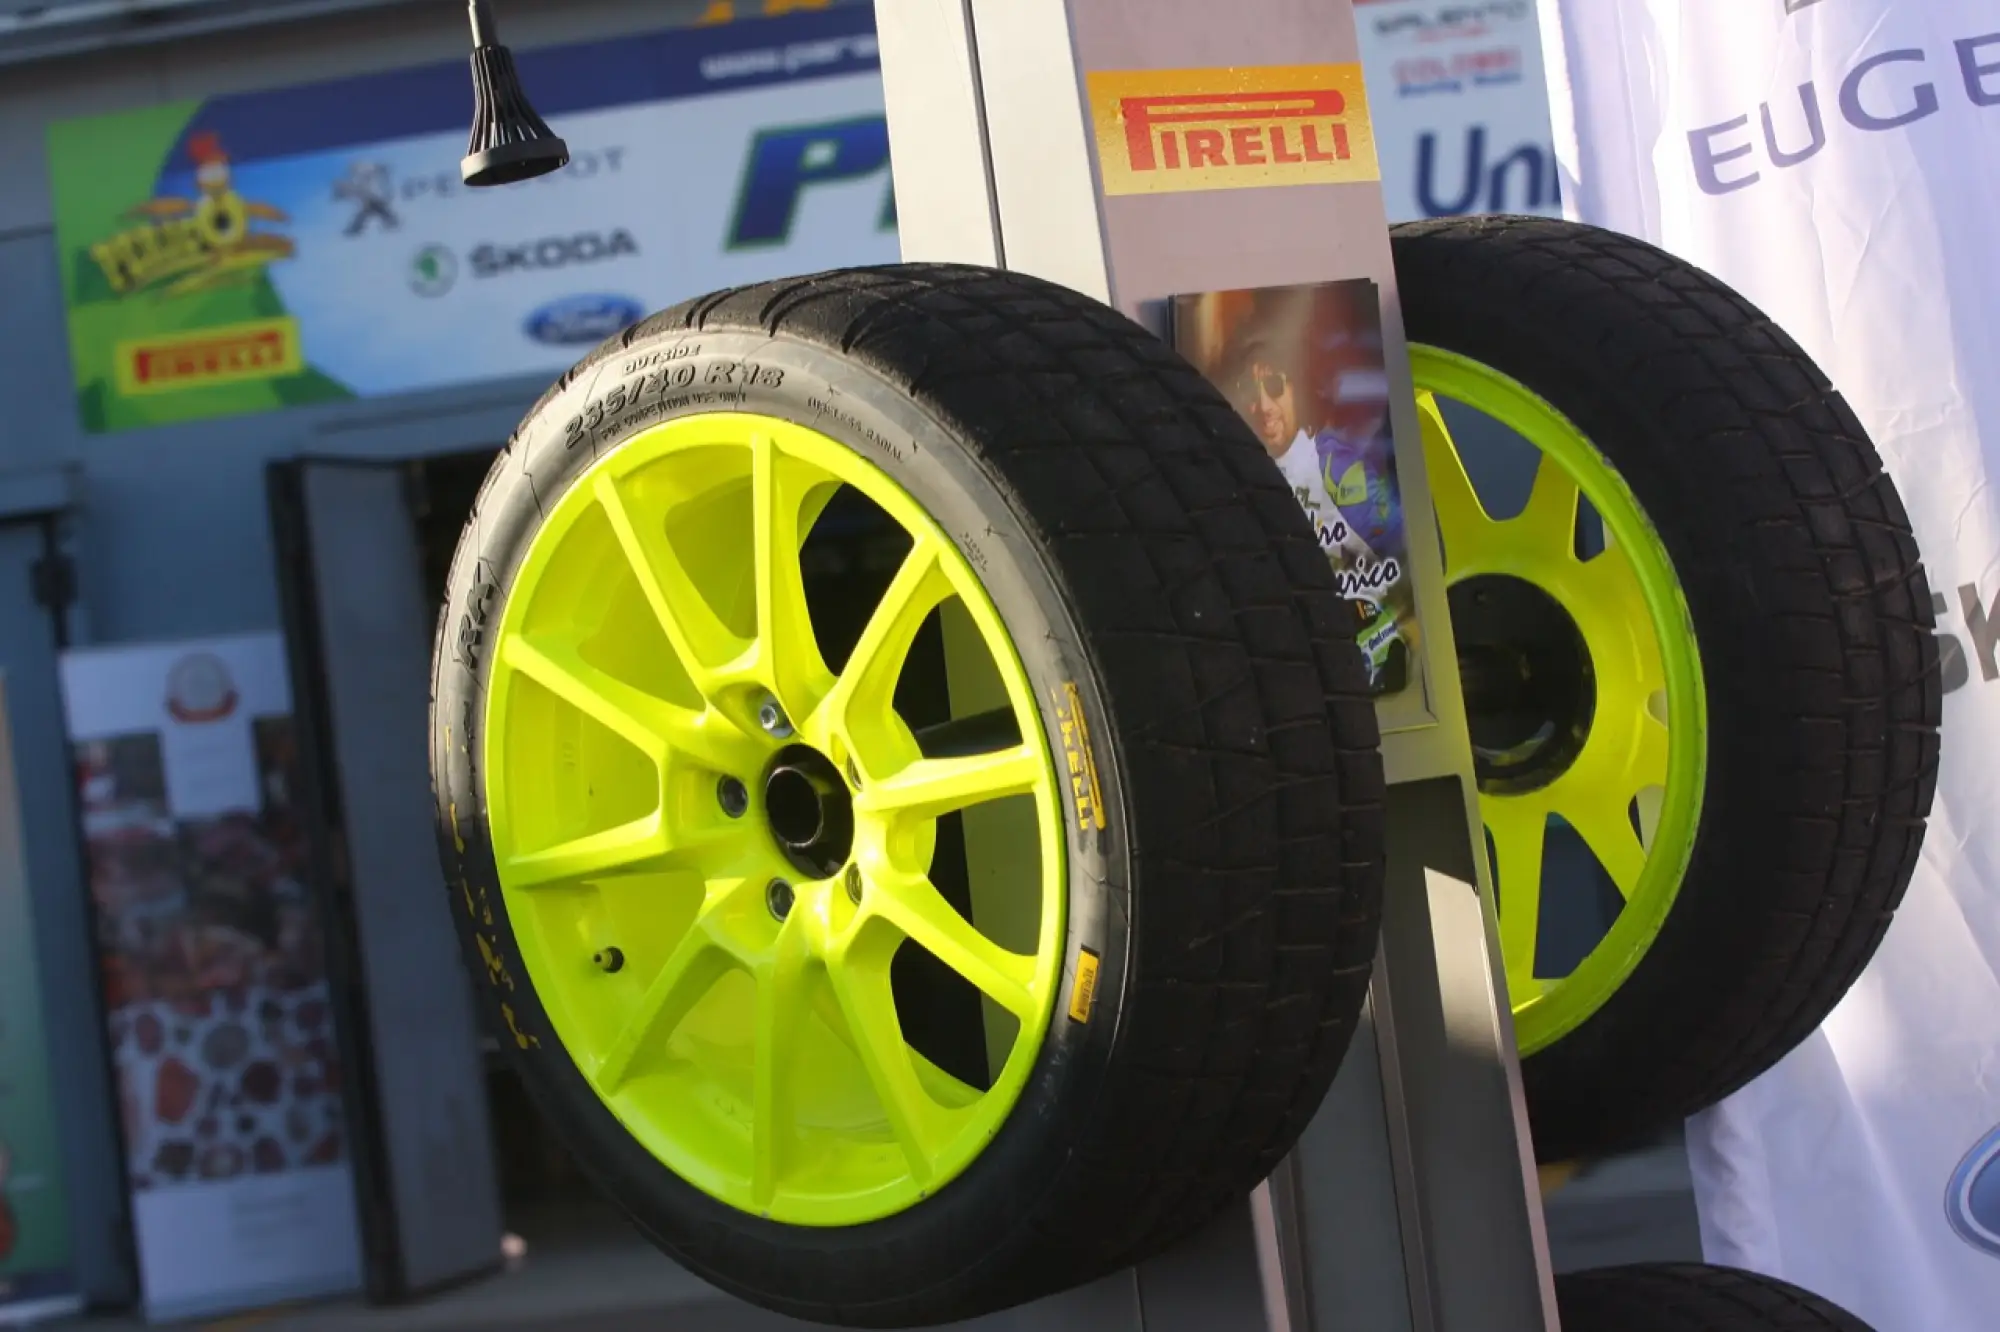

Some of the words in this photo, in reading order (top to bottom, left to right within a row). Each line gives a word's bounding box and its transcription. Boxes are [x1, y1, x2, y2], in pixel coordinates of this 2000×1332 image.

[1120, 89, 1351, 171] PIRELLI
[1416, 126, 1561, 217] Un
[722, 114, 898, 253] P
[622, 345, 701, 375] OUTSIDE
[565, 364, 696, 449] 235/40
